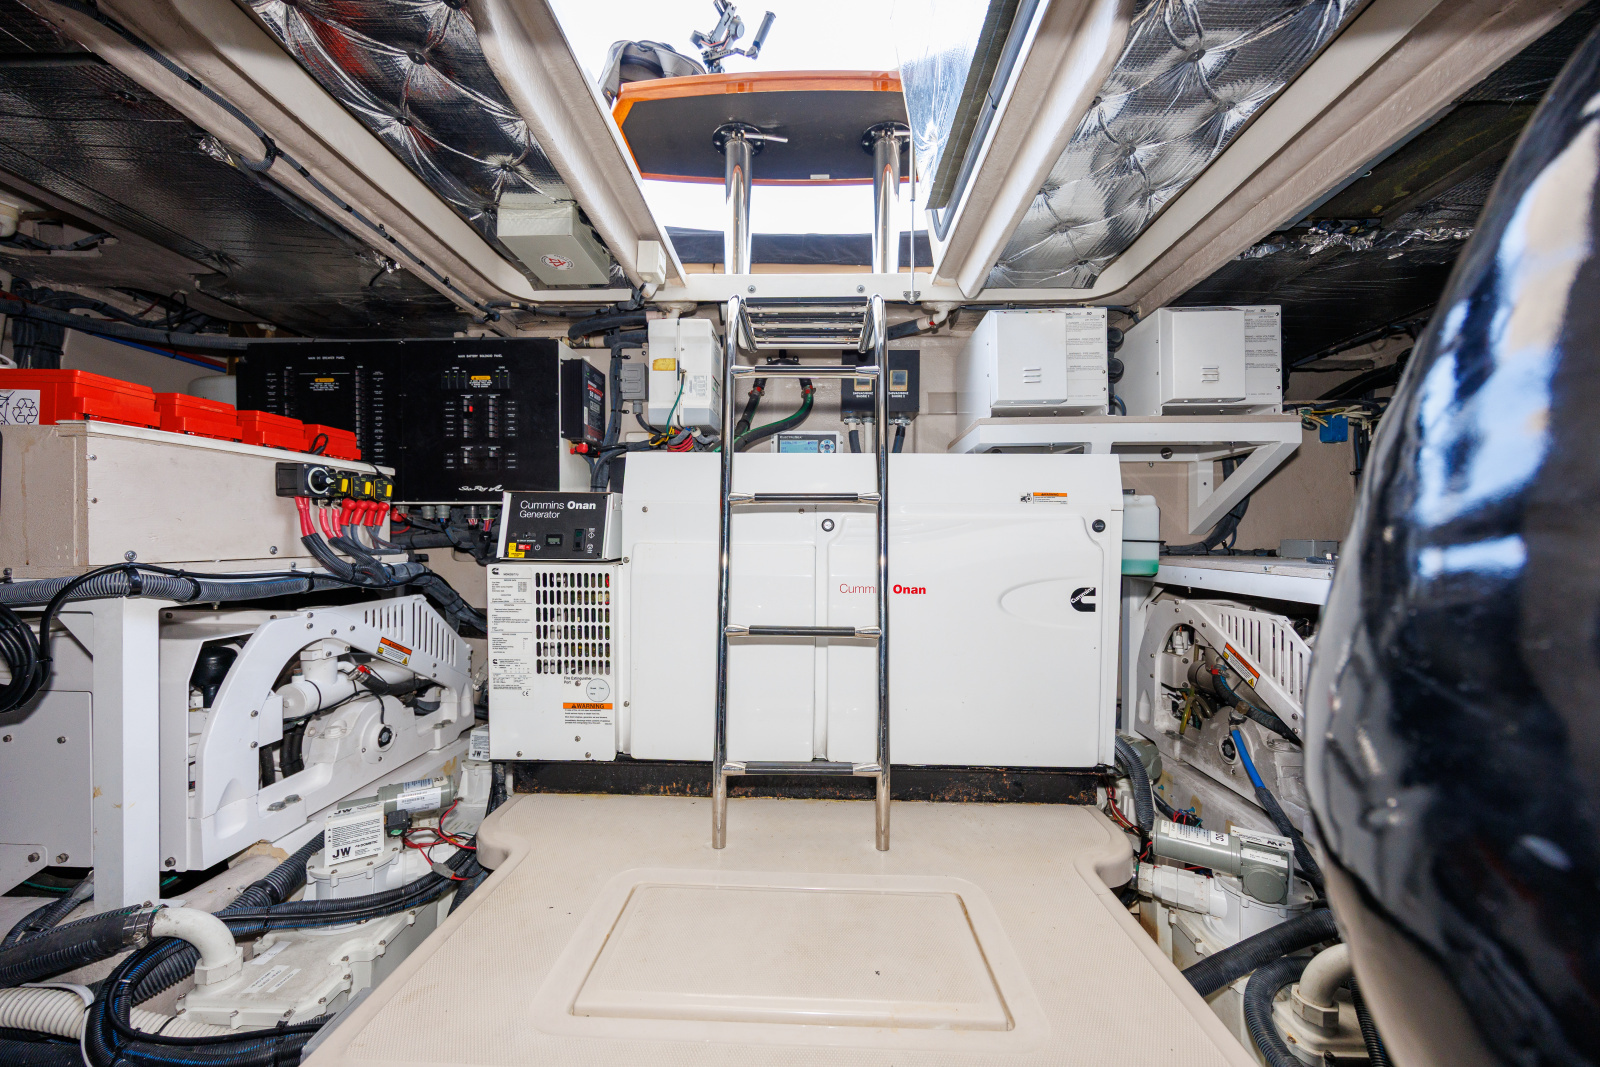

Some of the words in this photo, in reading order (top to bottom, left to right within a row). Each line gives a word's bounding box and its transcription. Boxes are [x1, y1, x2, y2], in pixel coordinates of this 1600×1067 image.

[520, 500, 565, 510] Cummins
[567, 501, 596, 510] Onan
[839, 583, 877, 594] Cummi
[893, 584, 926, 594] Onan
[332, 847, 351, 858] JW
